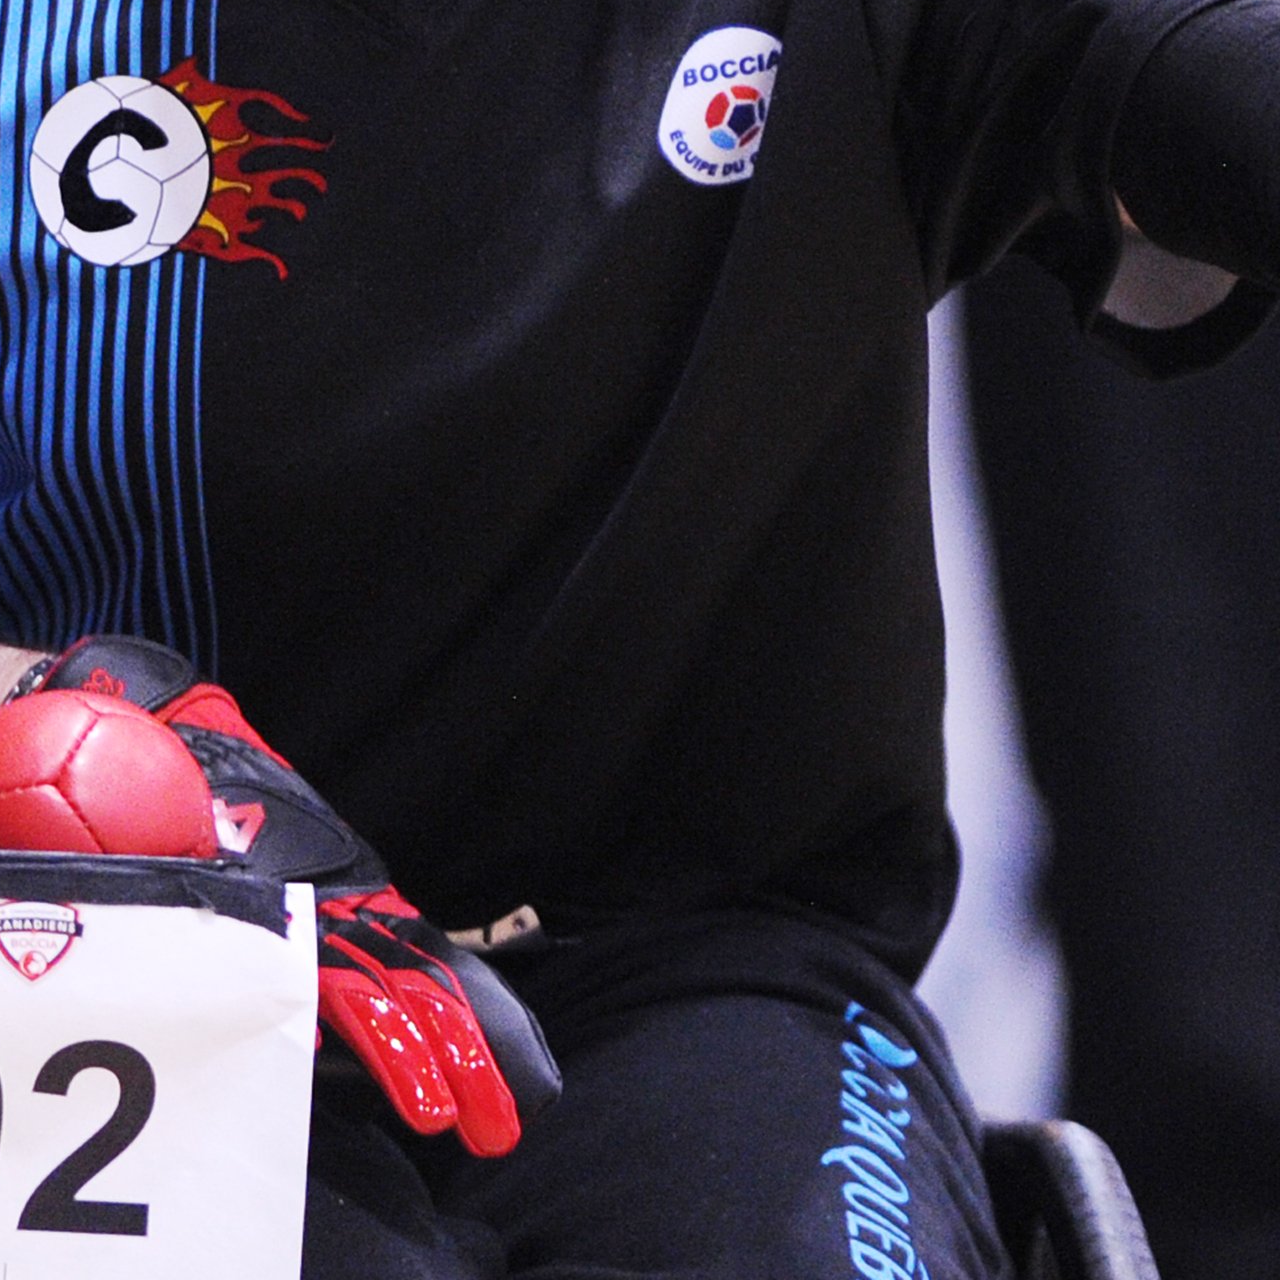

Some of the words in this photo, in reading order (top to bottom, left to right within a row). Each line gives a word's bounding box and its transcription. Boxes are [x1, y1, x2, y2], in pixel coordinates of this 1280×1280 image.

[59, 107, 169, 232] C
[722, 159, 745, 177] DU
[10, 937, 58, 951] BOCCIA
